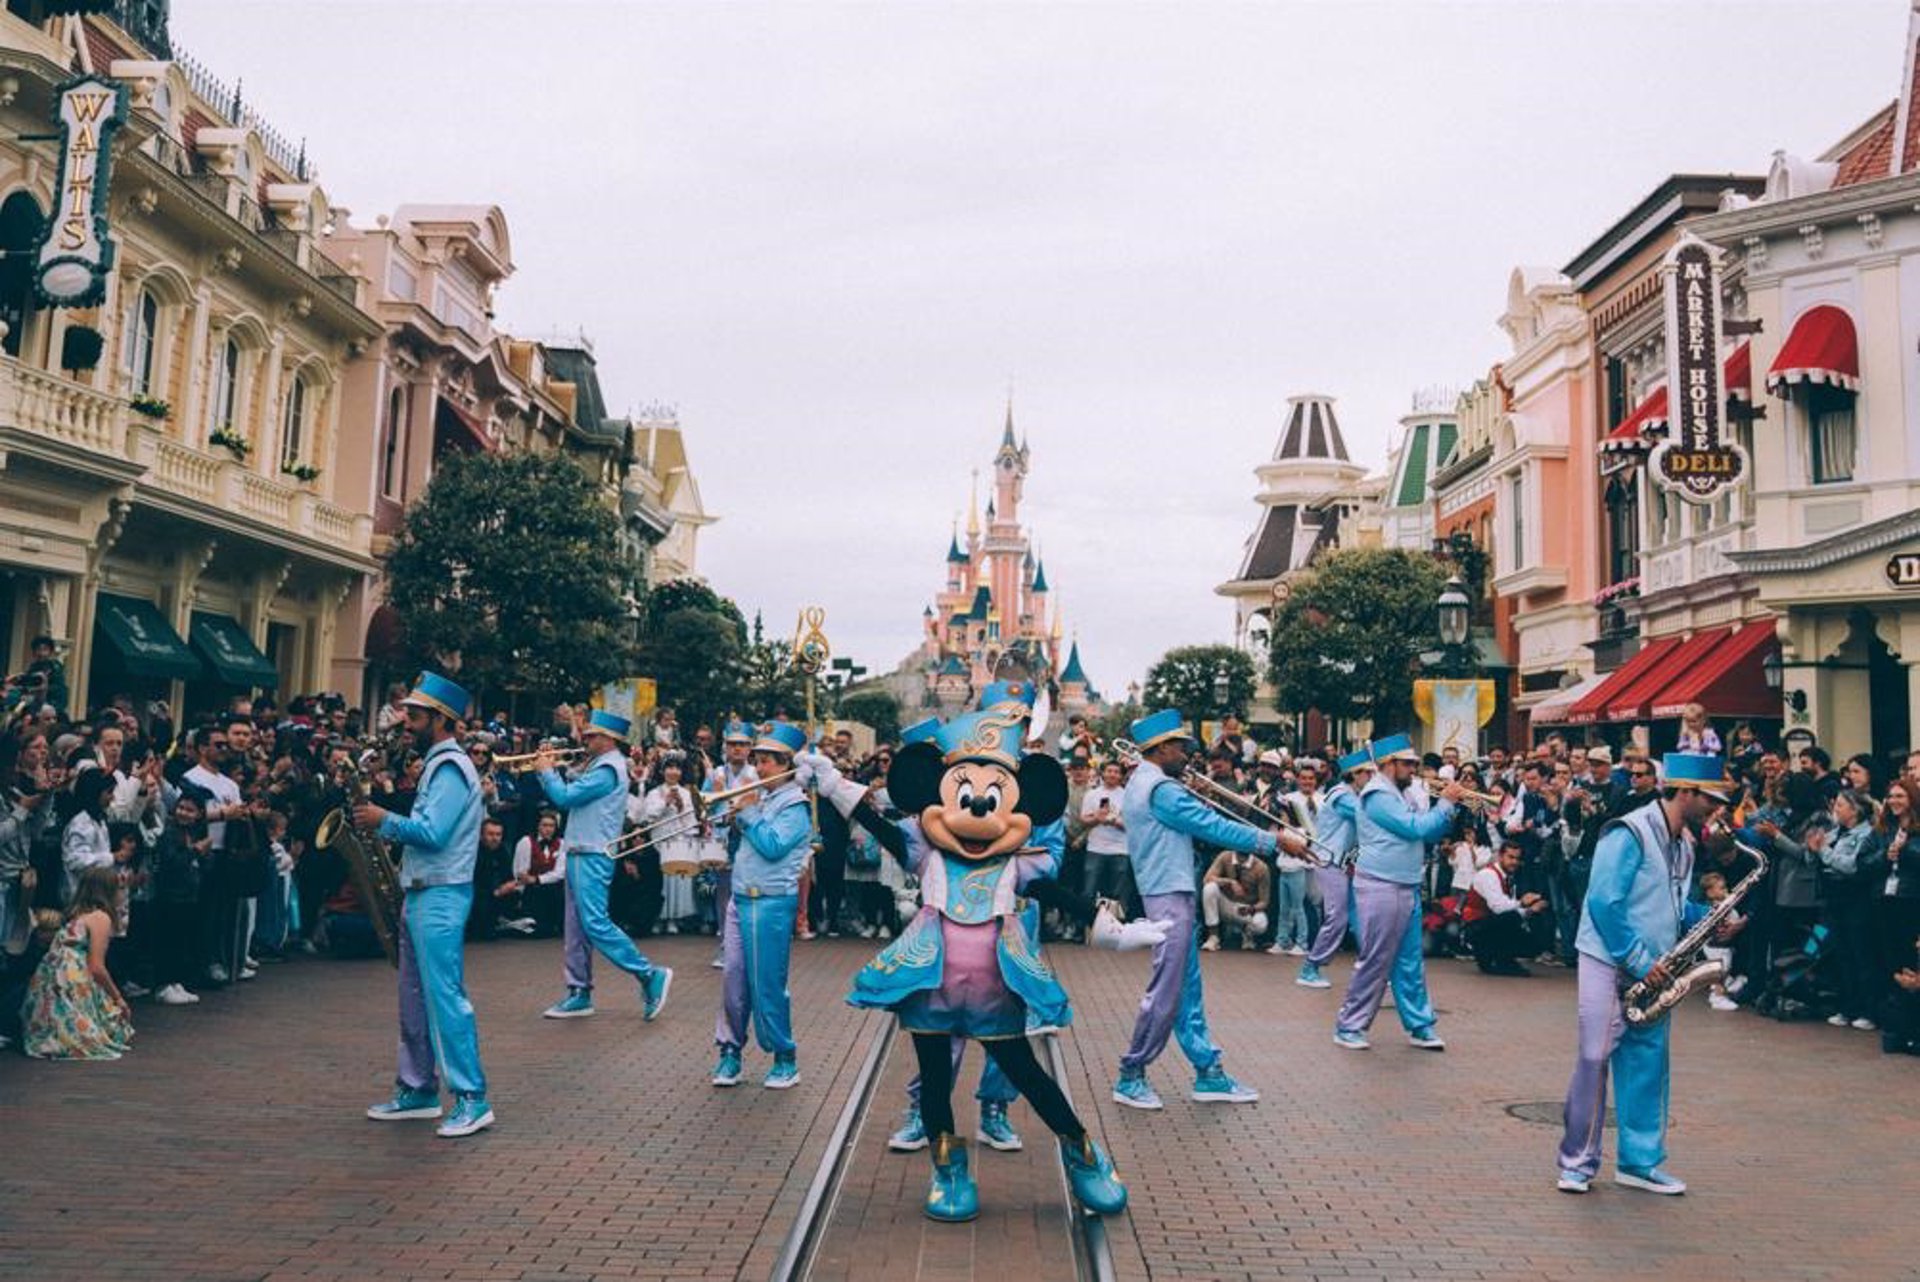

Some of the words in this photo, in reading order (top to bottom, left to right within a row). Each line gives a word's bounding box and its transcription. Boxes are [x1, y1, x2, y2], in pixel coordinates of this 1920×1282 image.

[1683, 262, 1706, 361] MARKET
[1690, 368, 1710, 451] HOUSE
[1671, 454, 1732, 472] DELI
